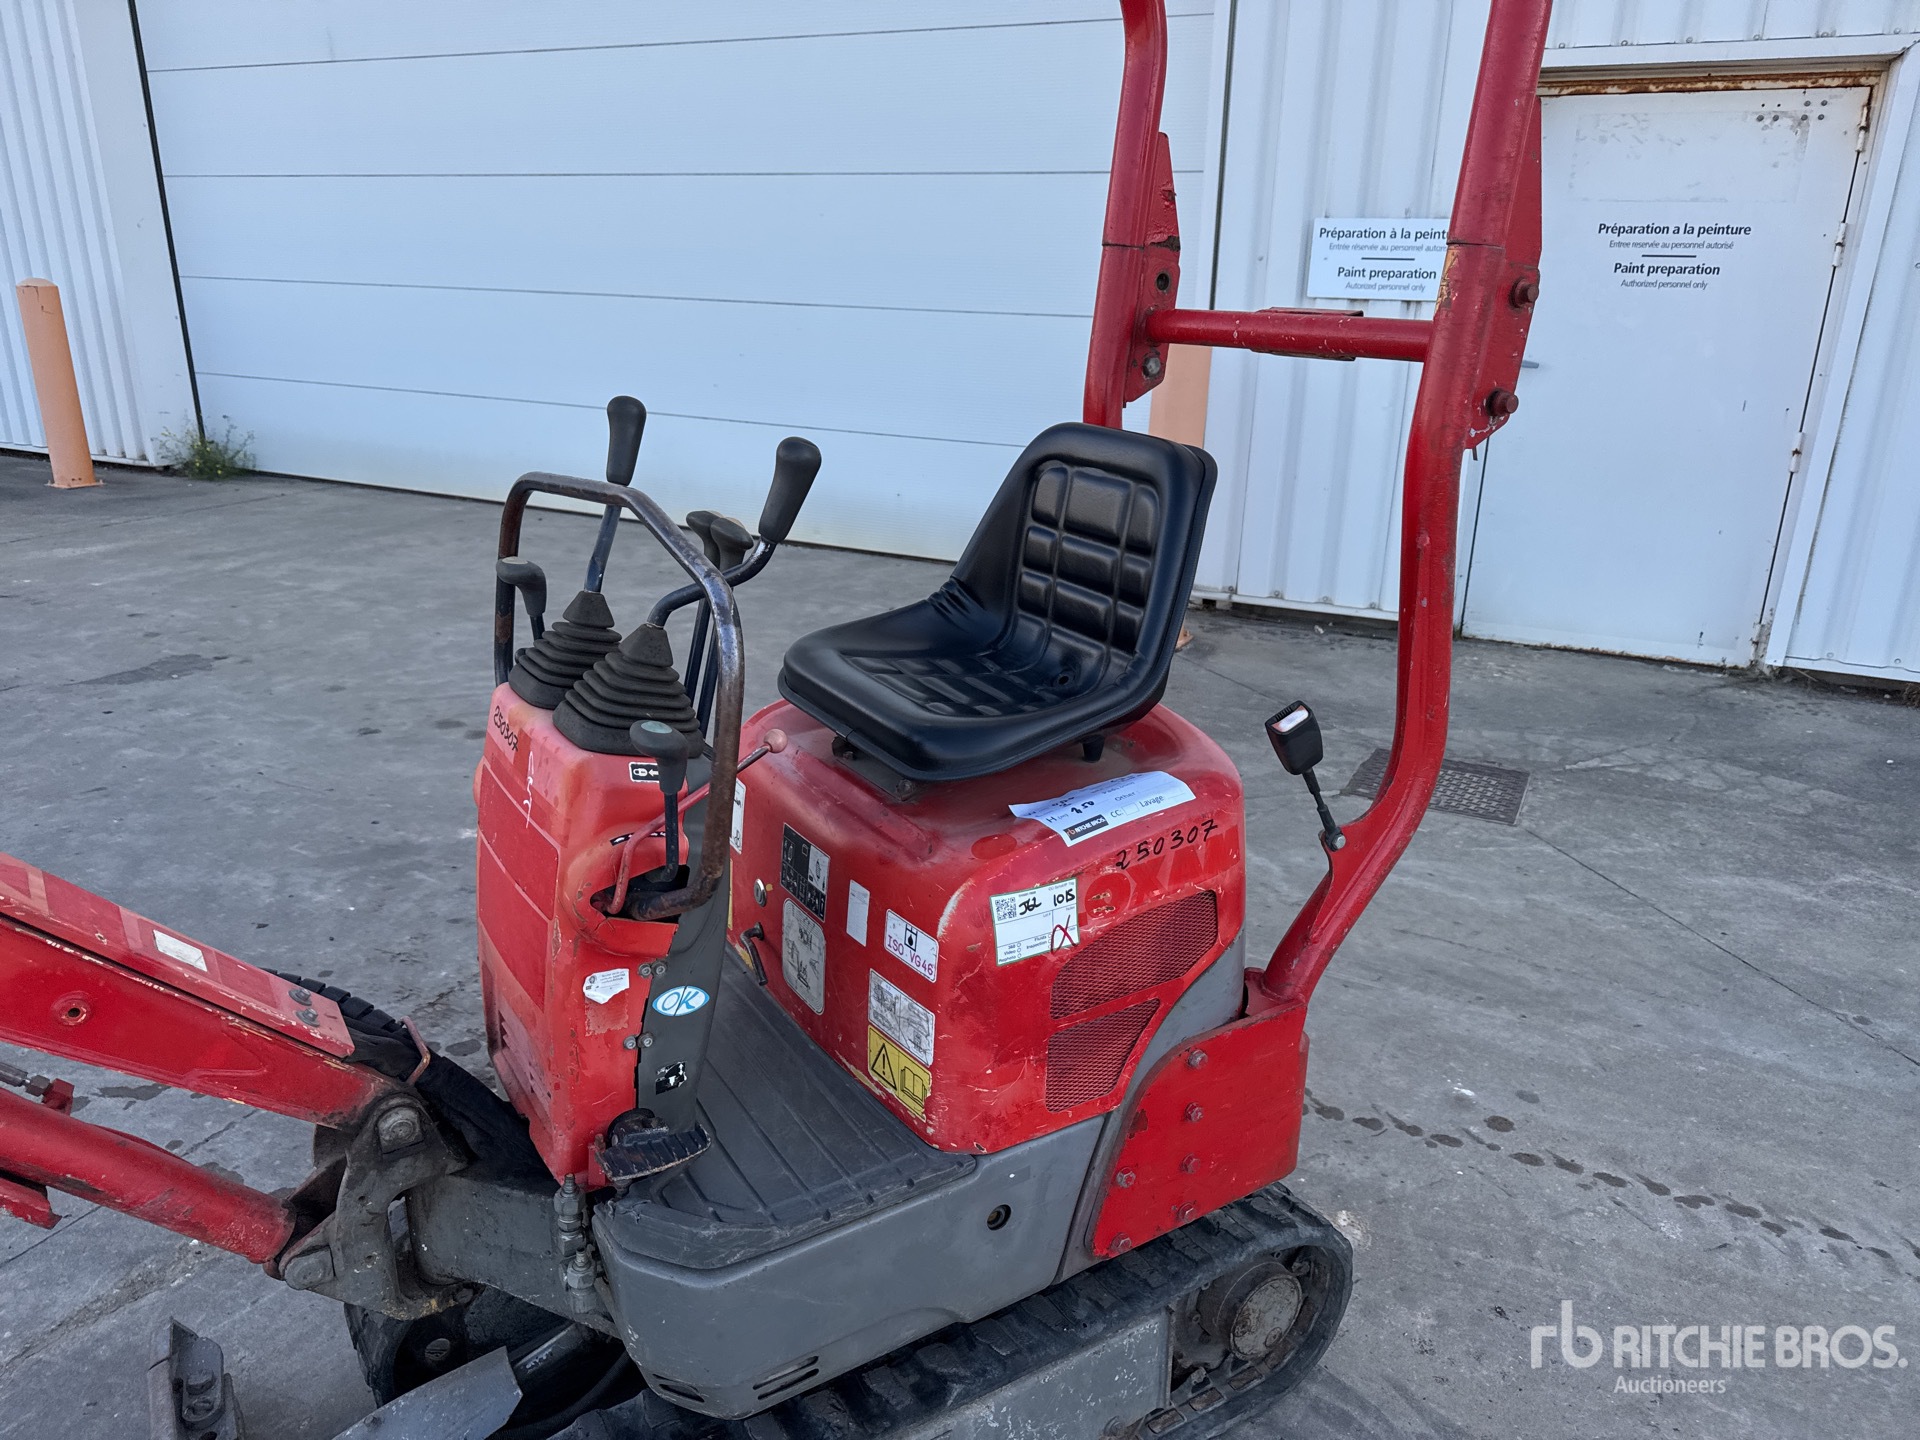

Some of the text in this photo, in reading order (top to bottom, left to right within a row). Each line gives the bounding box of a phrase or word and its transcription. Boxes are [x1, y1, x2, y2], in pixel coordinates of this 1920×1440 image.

[1319, 227, 1448, 242] Préparation à la peint
[1598, 222, 1670, 237] Préparation
[1683, 223, 1695, 235] la
[1697, 223, 1752, 238] peinture
[1390, 244, 1424, 252] personnel
[1670, 241, 1704, 250] personnel
[1706, 241, 1734, 250] autorisé
[1337, 266, 1438, 281] Paint preparation
[1614, 262, 1720, 277] Paint preparation
[1378, 284, 1410, 292] personnel
[1411, 284, 1426, 292] only
[1620, 279, 1708, 290] Authorized personnel only
[1139, 795, 1165, 808] Lavage
[1116, 818, 1218, 870] 250307
[888, 934, 934, 976] ISO VG46
[662, 990, 700, 1011] OK
